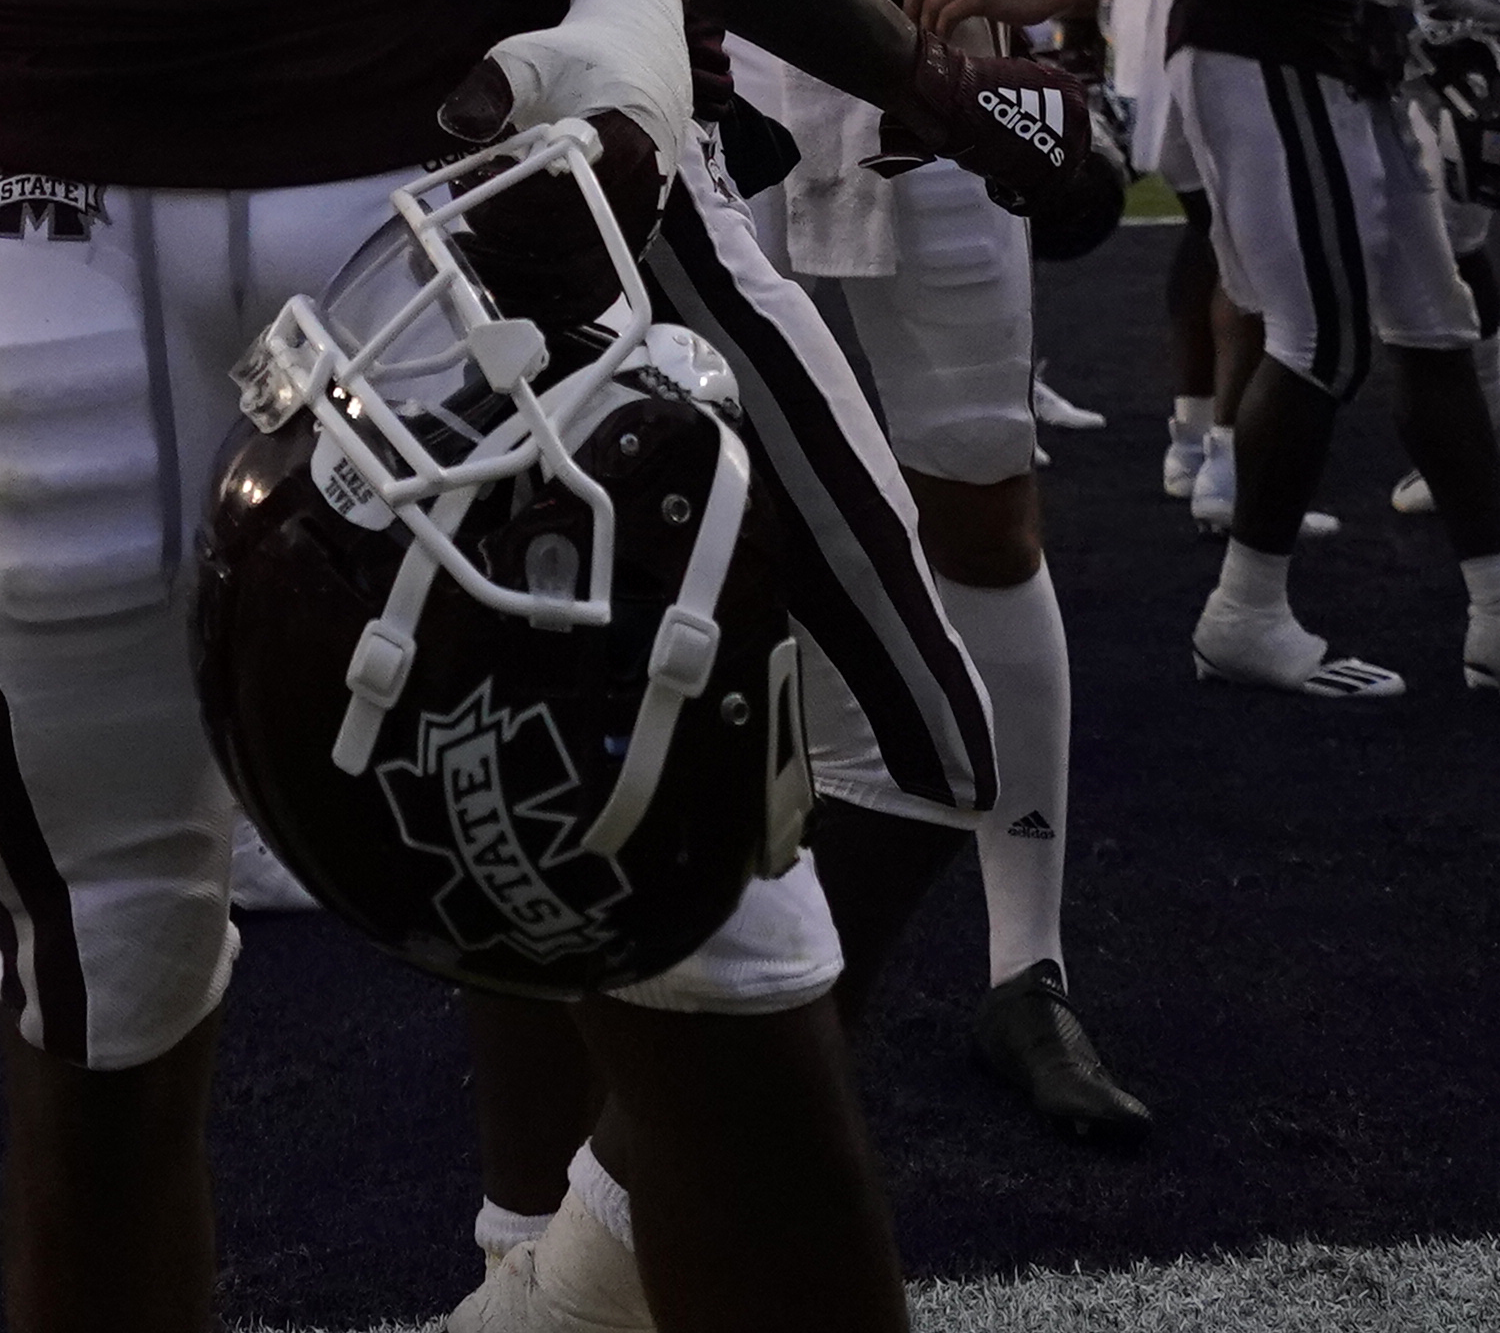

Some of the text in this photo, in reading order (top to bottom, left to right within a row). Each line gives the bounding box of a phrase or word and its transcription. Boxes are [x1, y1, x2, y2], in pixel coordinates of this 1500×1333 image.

[976, 88, 1066, 169] adidas
[1, 176, 78, 202] STATE
[456, 751, 561, 926] STATE
